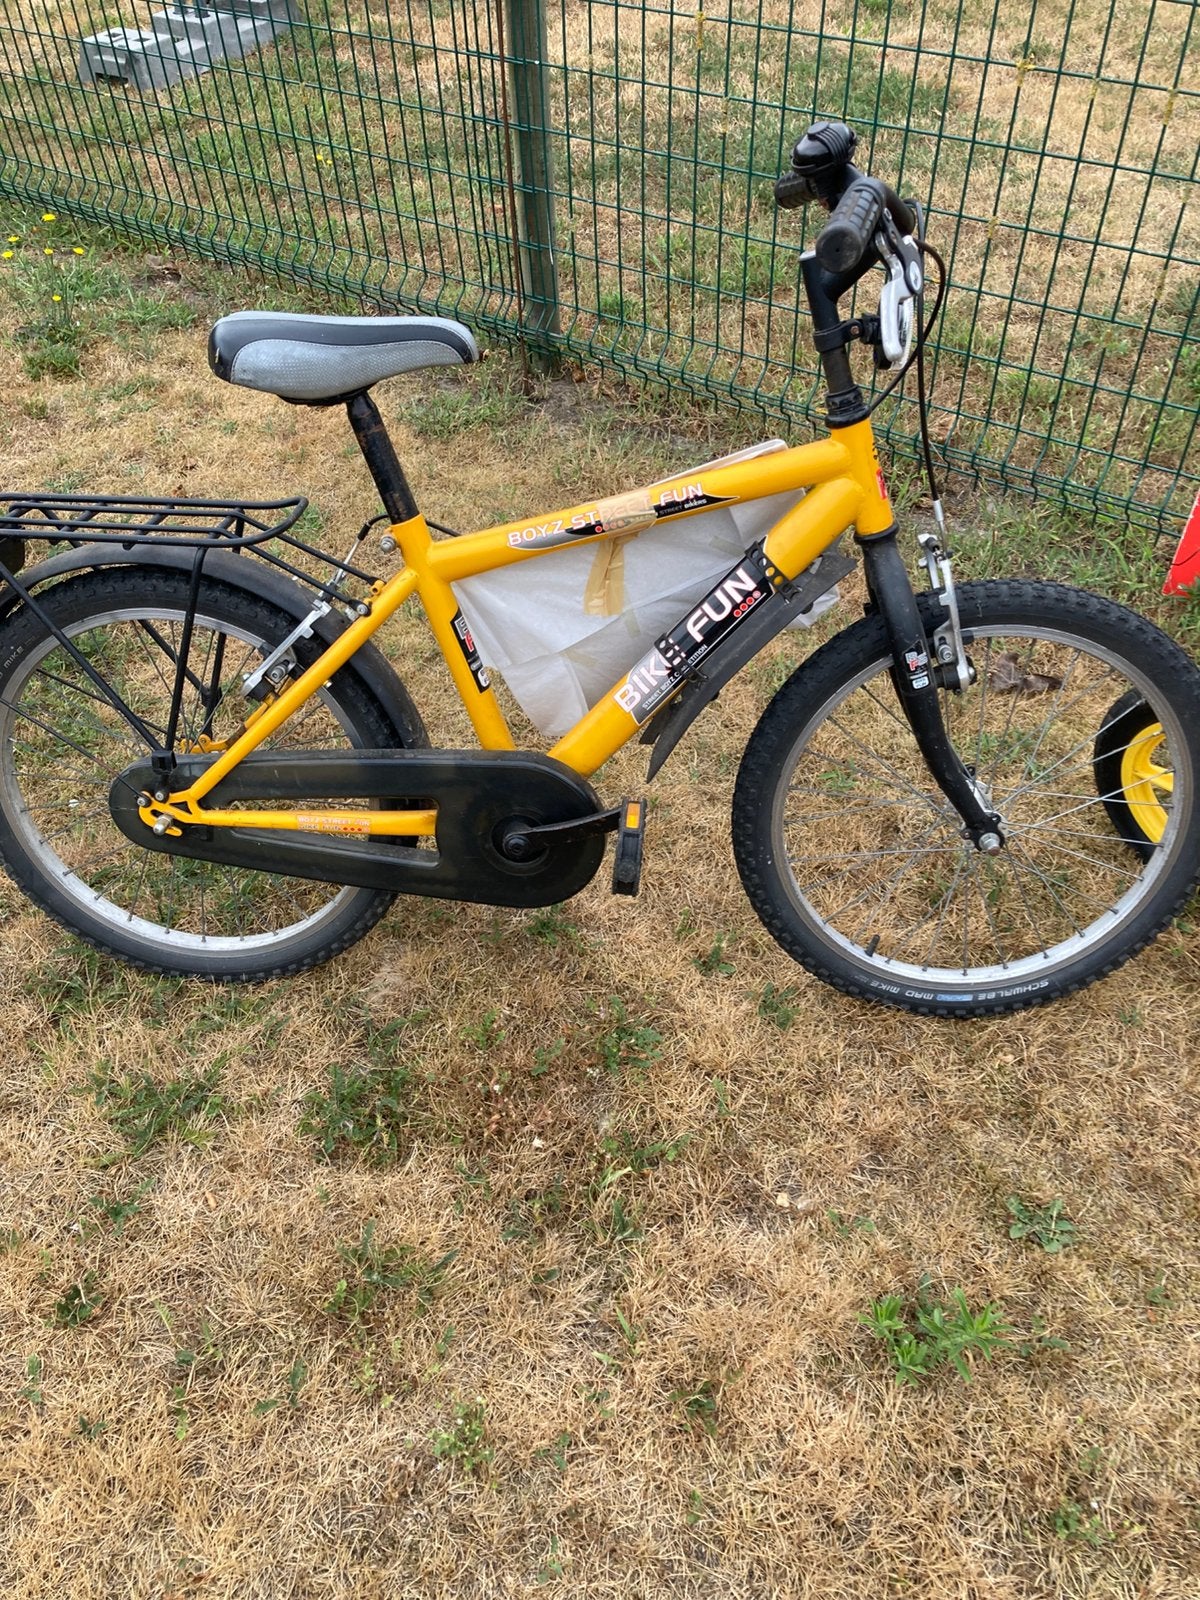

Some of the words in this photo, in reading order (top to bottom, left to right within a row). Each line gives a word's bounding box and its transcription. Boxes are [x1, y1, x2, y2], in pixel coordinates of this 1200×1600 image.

[508, 520, 566, 546] BOYZ
[659, 483, 704, 506] FUN
[686, 567, 757, 643] FUN
[3, 646, 24, 668] MIKE
[869, 980, 900, 994] MIKE
[905, 989, 934, 1000] MAD
[978, 978, 1049, 1000] SCHWALBE
